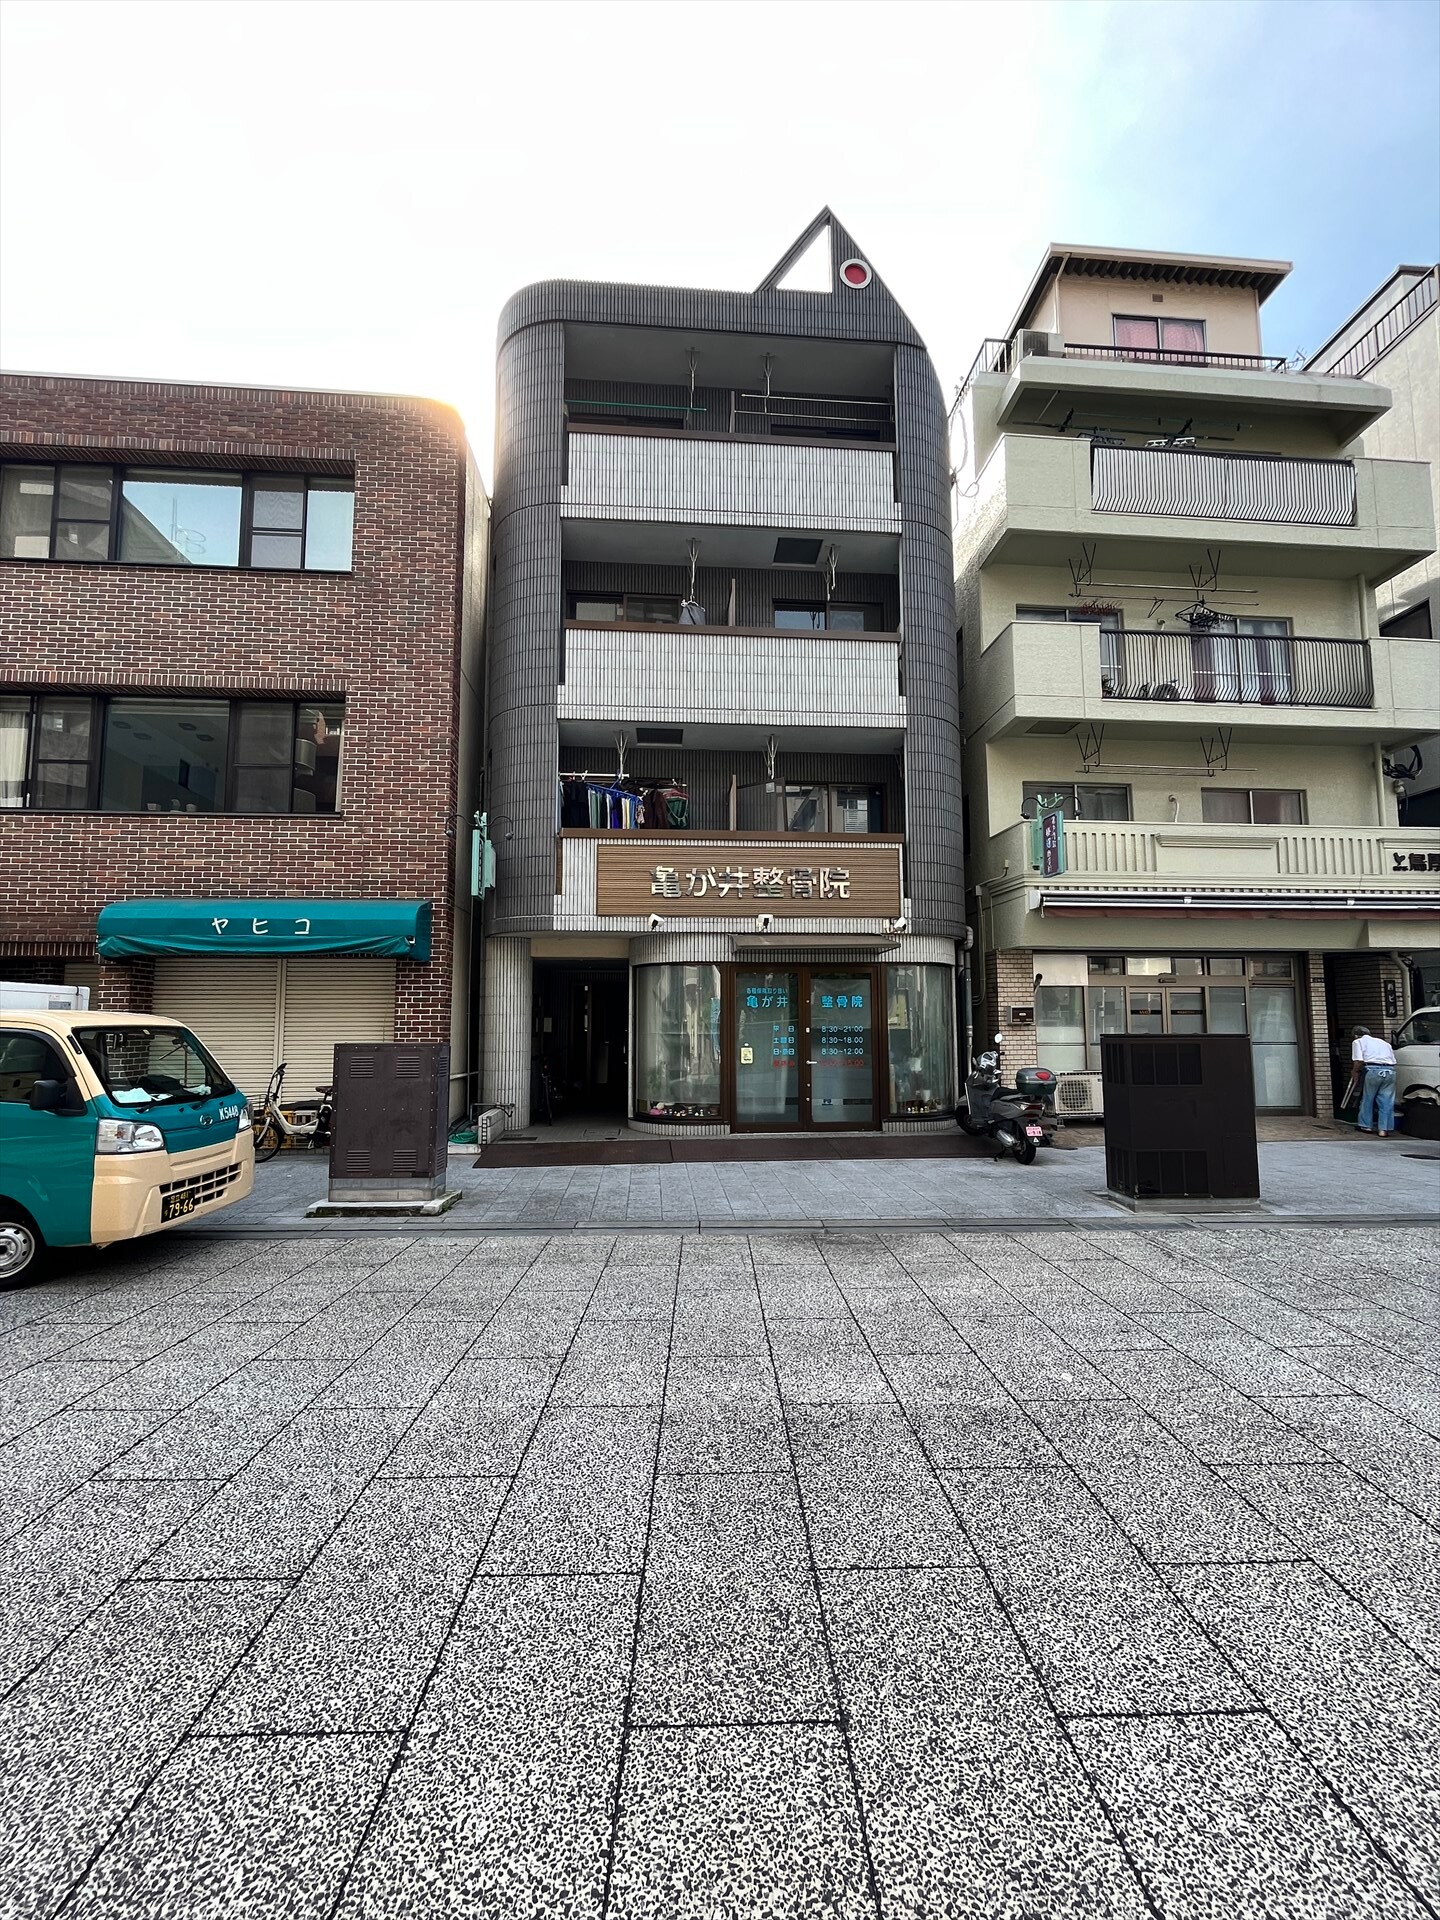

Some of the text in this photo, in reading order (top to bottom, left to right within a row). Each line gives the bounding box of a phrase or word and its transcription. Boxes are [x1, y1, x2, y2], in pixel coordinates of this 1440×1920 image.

[650, 865, 851, 899] 亀が井整骨院
[211, 917, 311, 935] ヤヒコ
[746, 995, 863, 1008] 亀が井 整骨院
[219, 1104, 239, 1120] K5448
